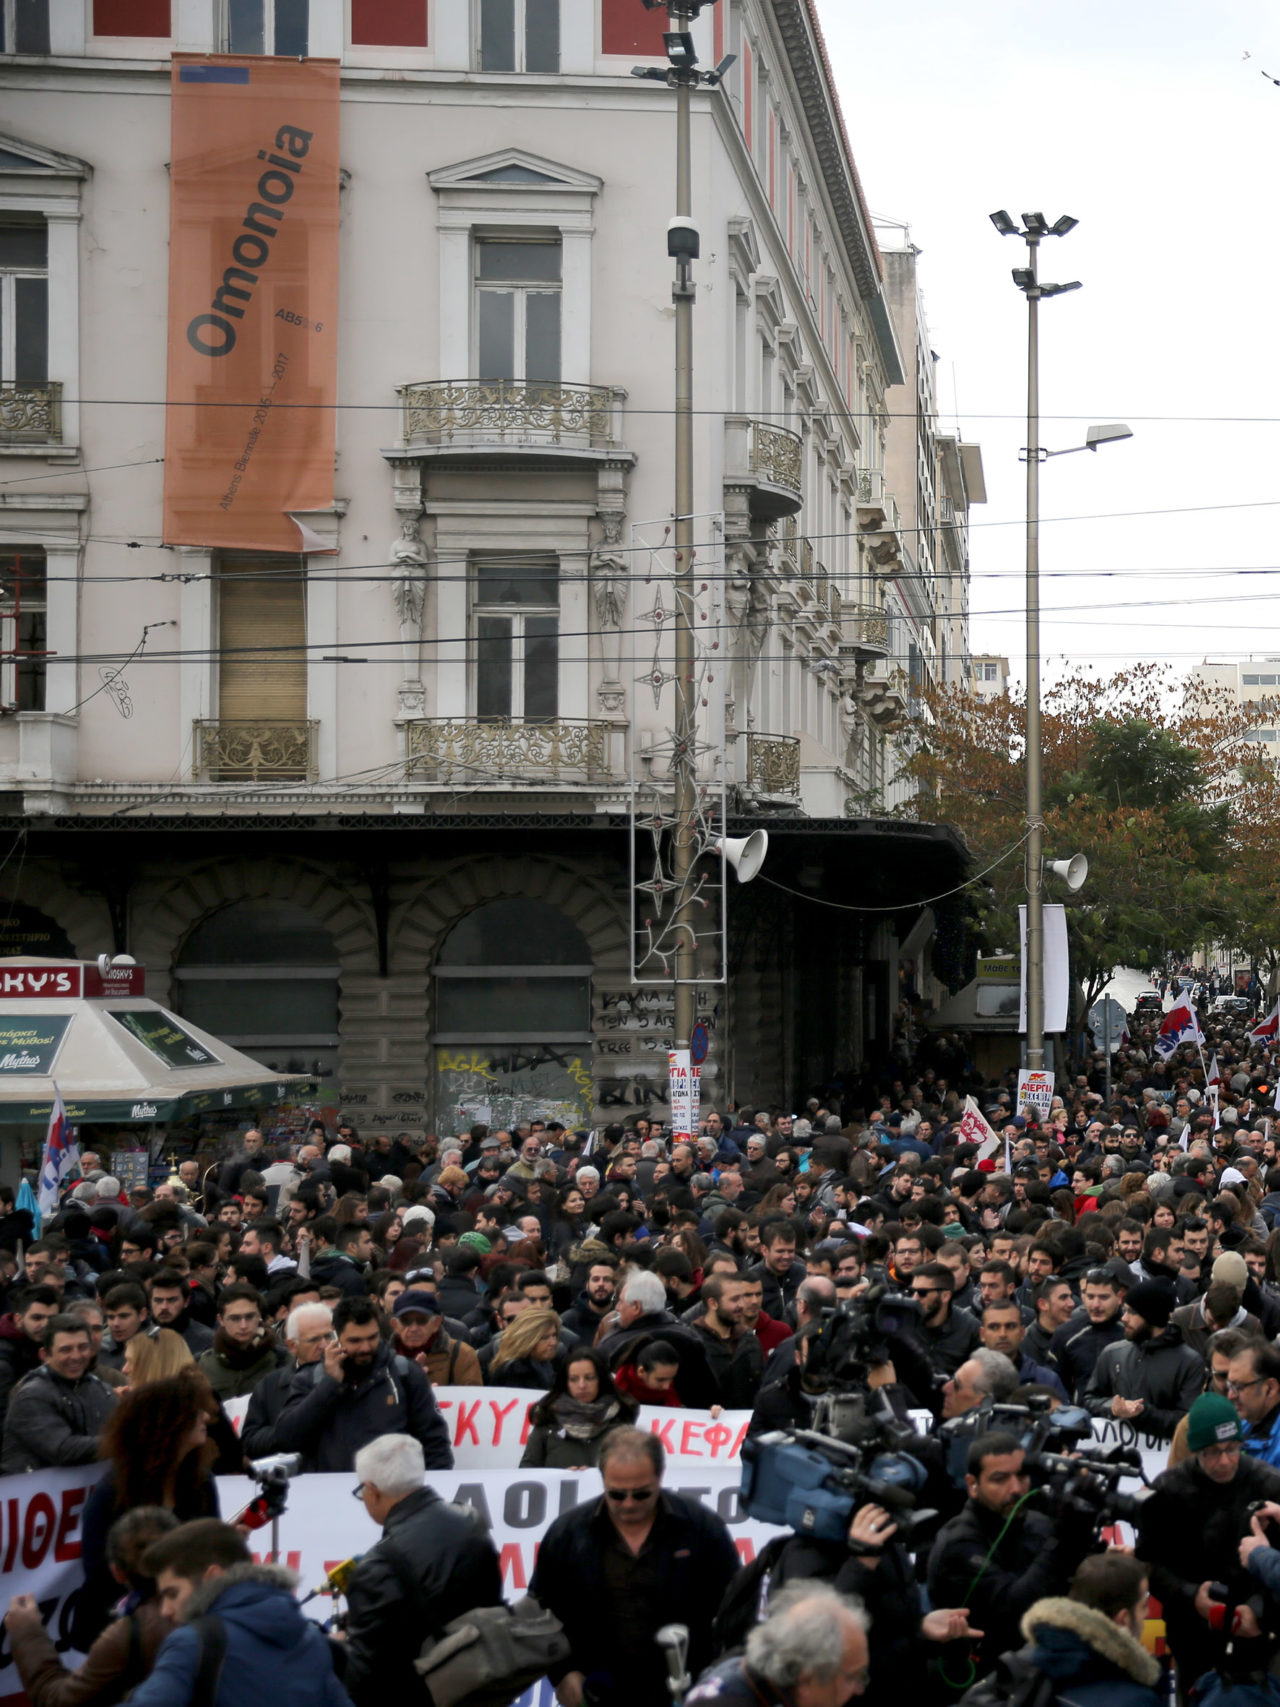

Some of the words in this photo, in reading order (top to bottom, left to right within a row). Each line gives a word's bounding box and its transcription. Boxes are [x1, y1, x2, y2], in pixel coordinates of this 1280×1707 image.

[186, 123, 314, 358] Omonoia
[0, 1052, 41, 1069] Mythos
[131, 1103, 158, 1119] Mythos
